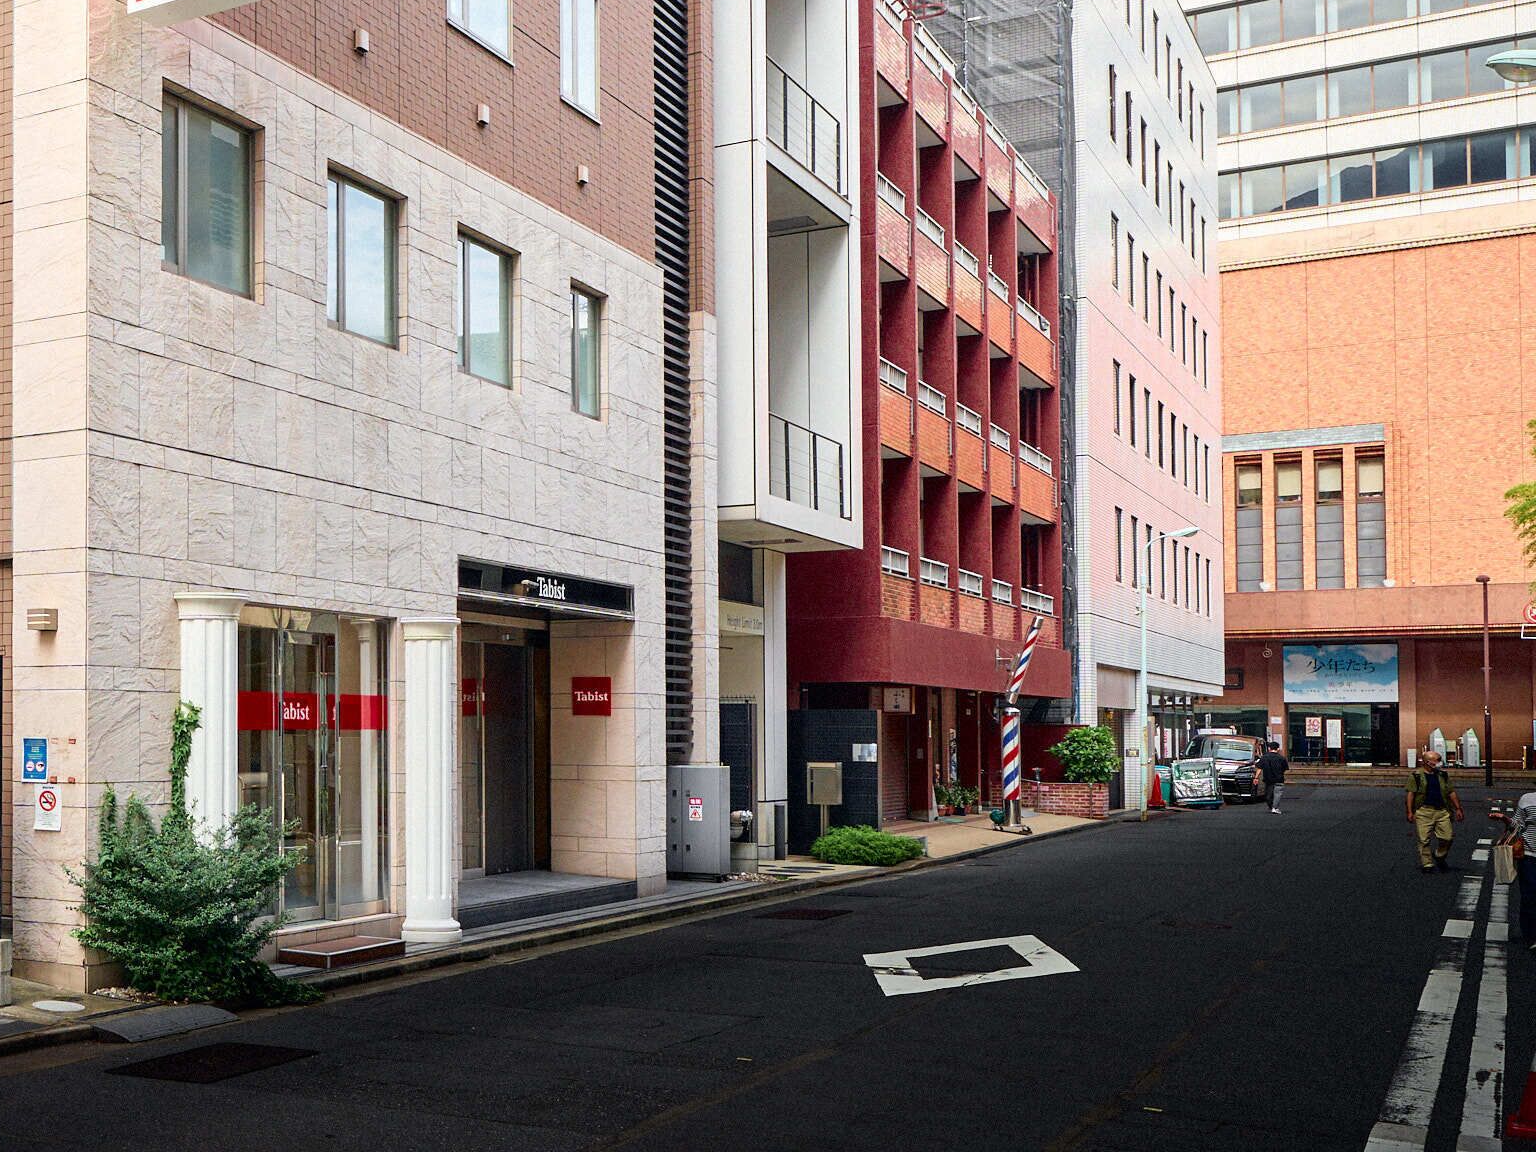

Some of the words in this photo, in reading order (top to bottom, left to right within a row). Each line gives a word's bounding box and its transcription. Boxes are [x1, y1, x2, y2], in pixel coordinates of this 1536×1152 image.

[537, 576, 566, 600] Tabist
[1306, 658, 1376, 674] 少年たち
[575, 691, 609, 702] Tabist
[282, 702, 310, 720] abist
